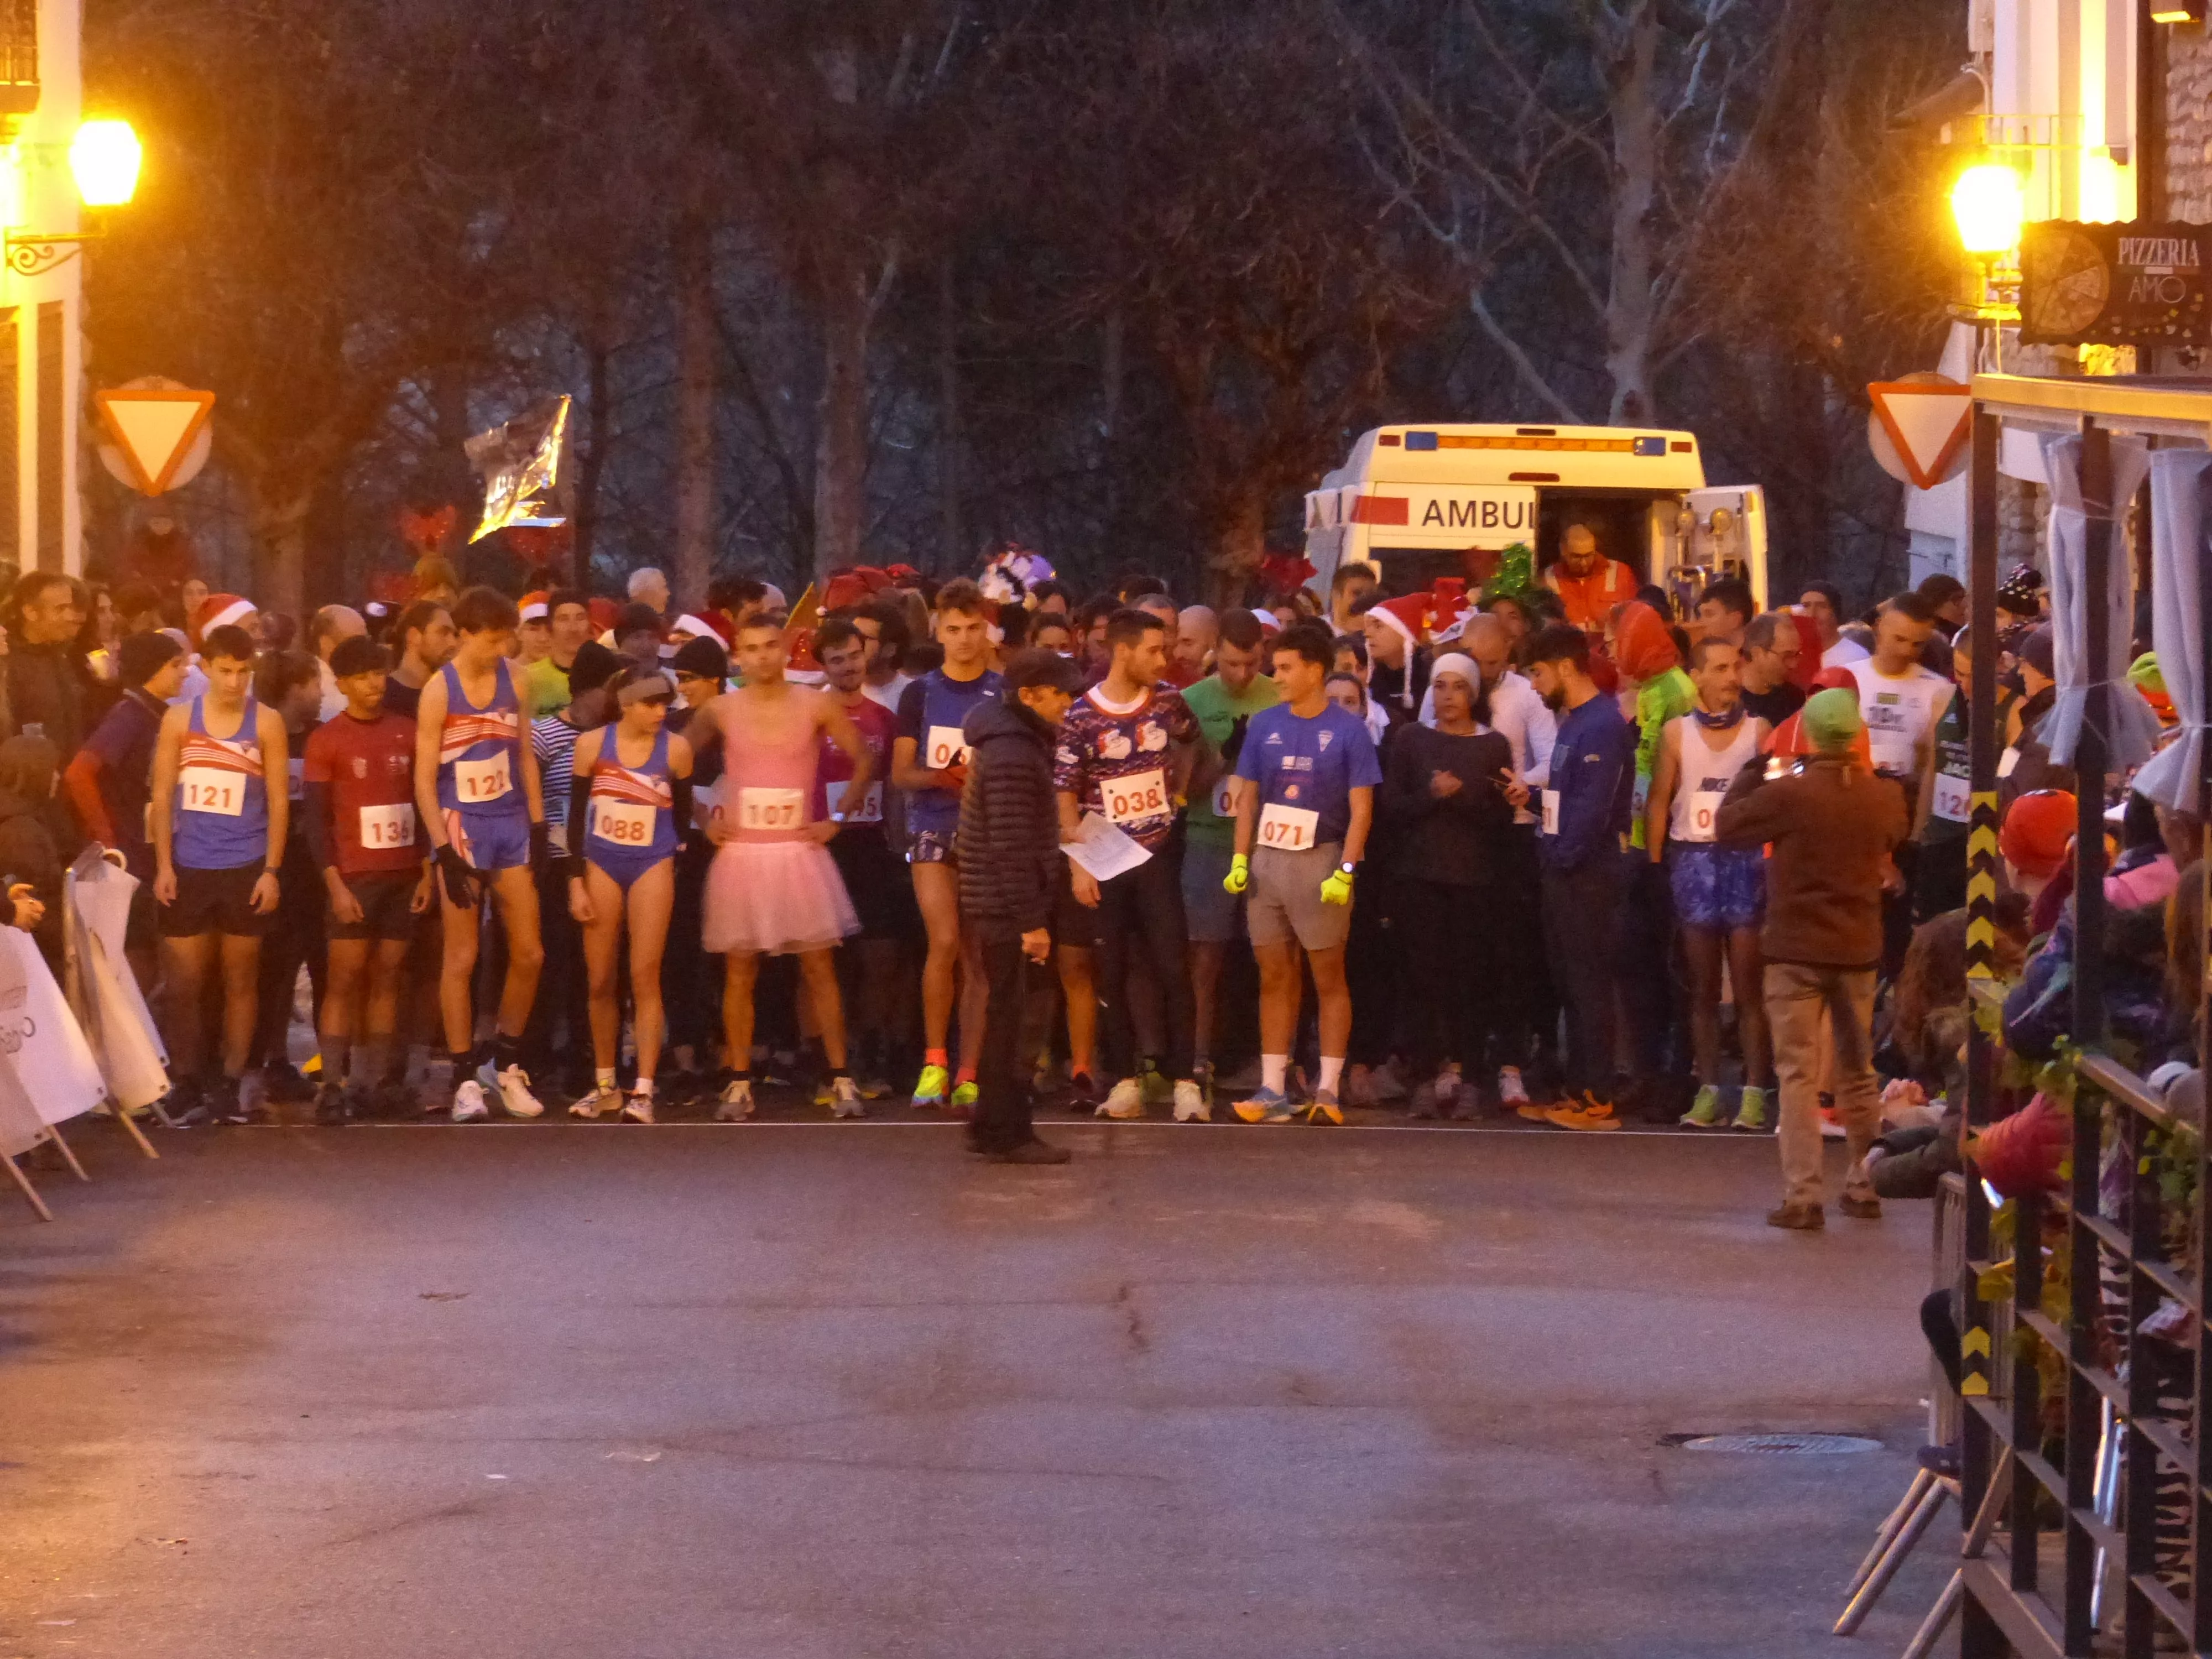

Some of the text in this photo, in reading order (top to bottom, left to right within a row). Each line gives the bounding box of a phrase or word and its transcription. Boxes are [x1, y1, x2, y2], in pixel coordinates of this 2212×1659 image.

[2117, 237, 2200, 267] PIZZERIA
[2128, 276, 2187, 303] AMO
[190, 784, 231, 808] 121
[1113, 788, 1158, 816] 038
[748, 804, 795, 825] 107
[601, 815, 645, 842] 088
[1264, 821, 1303, 846] 071
